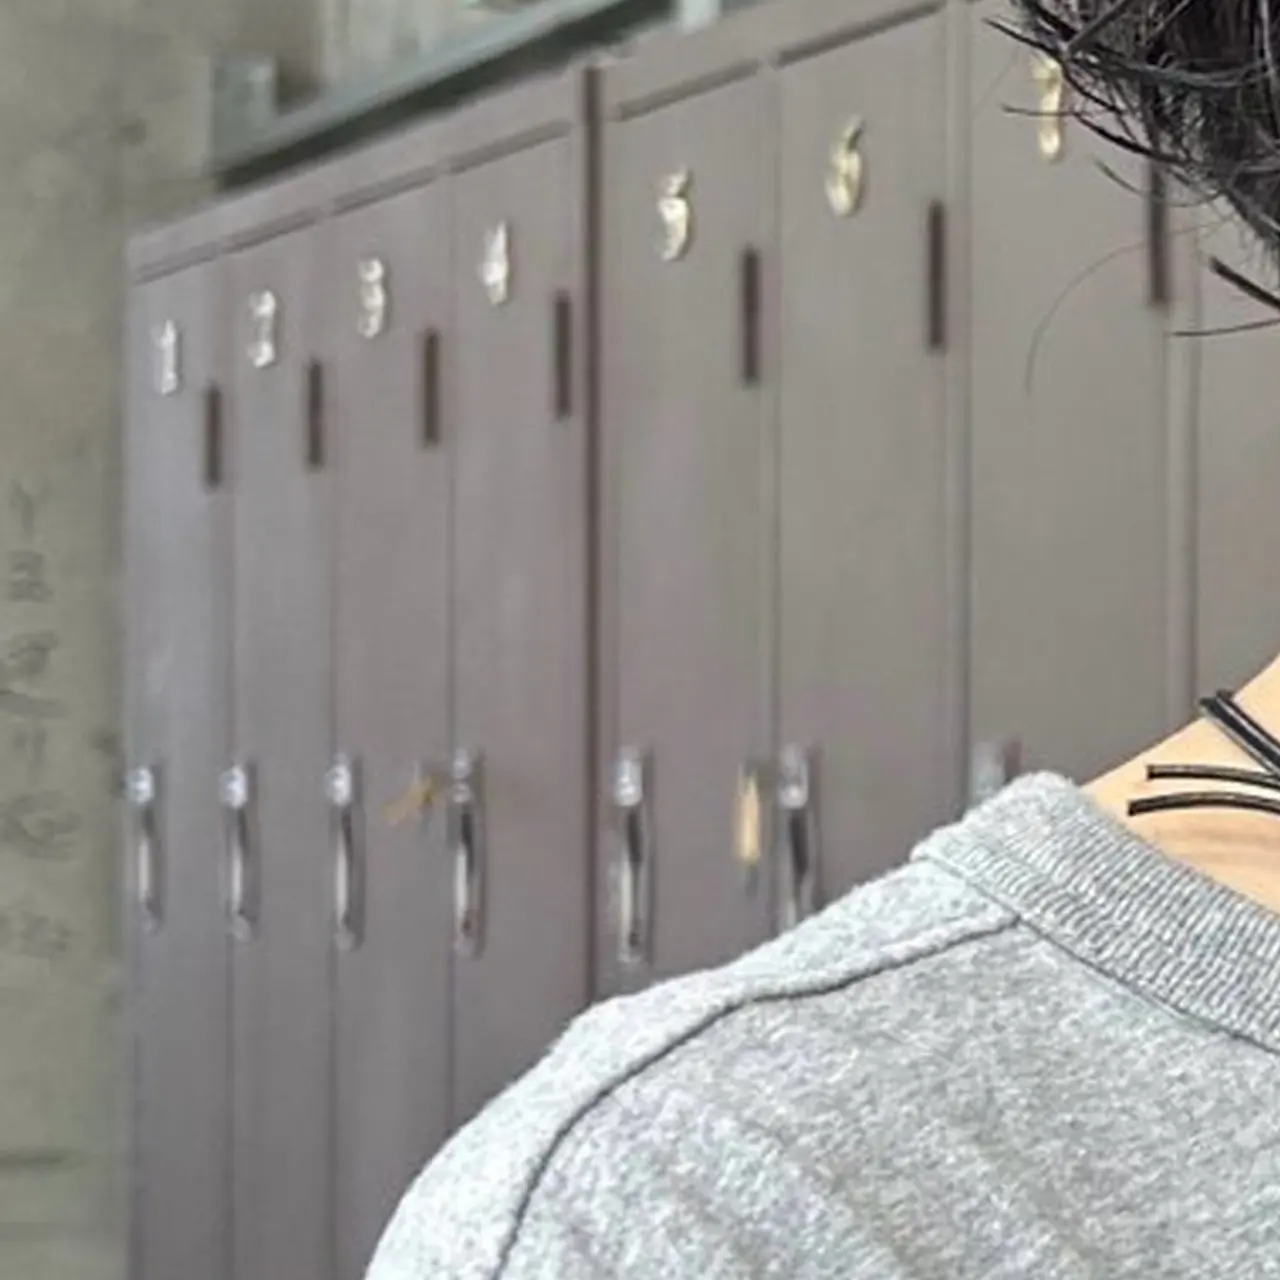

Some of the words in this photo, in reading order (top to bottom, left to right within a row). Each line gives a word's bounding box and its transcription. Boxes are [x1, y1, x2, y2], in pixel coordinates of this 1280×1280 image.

[658, 165, 690, 262] 5
[825, 115, 863, 217] 6
[358, 257, 386, 338] 3
